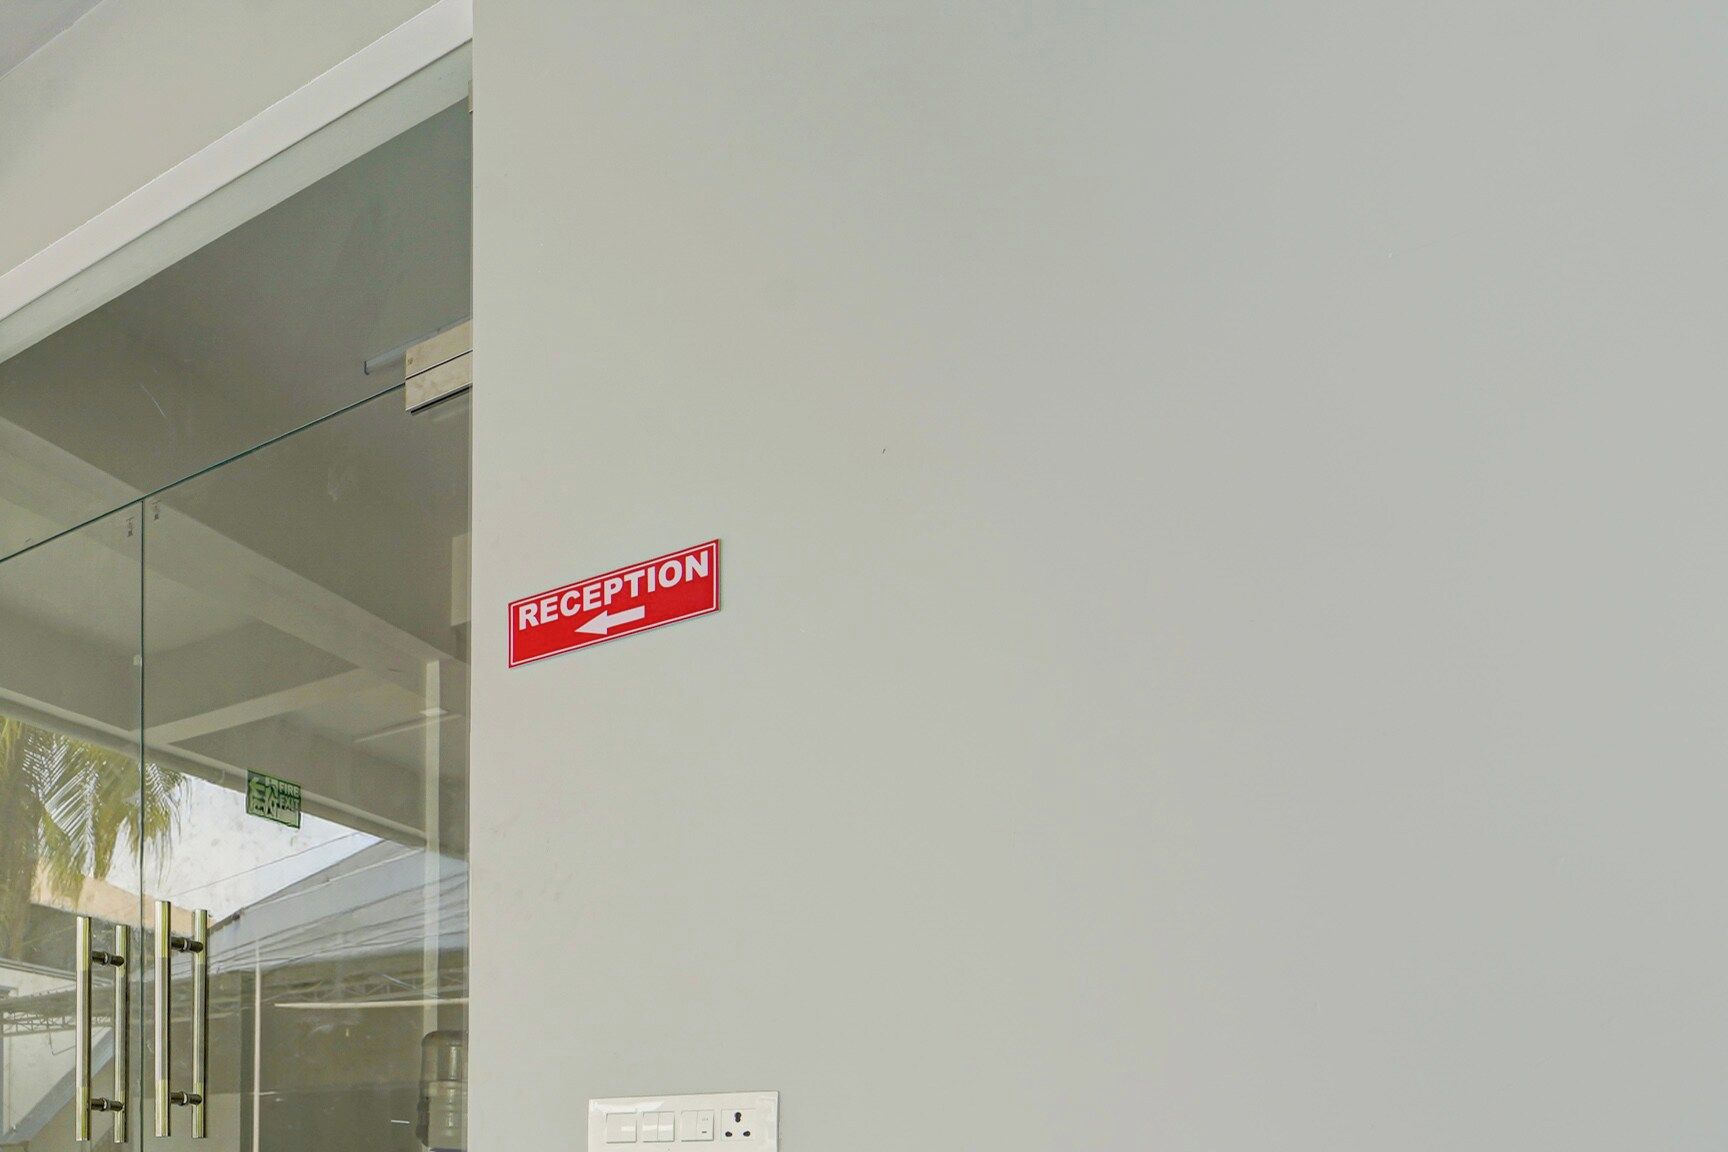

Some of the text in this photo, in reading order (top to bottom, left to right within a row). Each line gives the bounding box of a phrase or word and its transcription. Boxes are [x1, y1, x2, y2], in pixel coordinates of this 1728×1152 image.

[518, 550, 709, 631] RECEPTION
[278, 781, 299, 797] FIRE
[279, 795, 300, 811] EXIT
